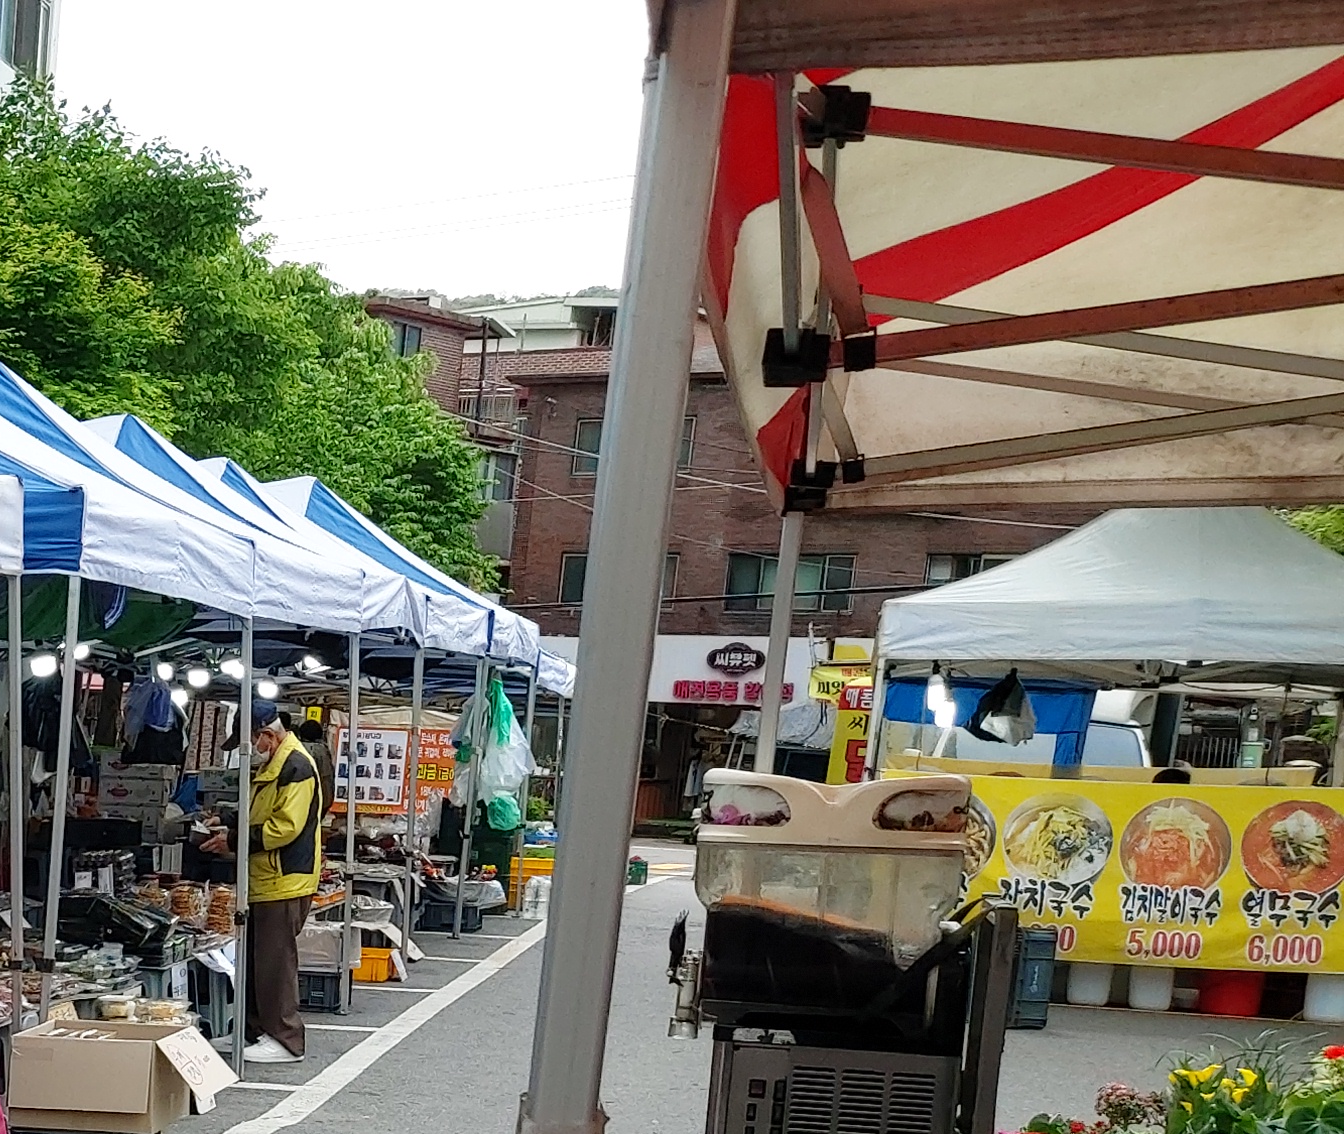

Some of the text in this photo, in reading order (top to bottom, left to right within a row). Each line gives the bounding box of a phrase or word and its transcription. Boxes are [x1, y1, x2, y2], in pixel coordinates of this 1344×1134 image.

[1120, 883, 1224, 924] 김치말이국수
[1241, 888, 1343, 929] 열무국수
[1126, 929, 1324, 965] 5,000 6,000
